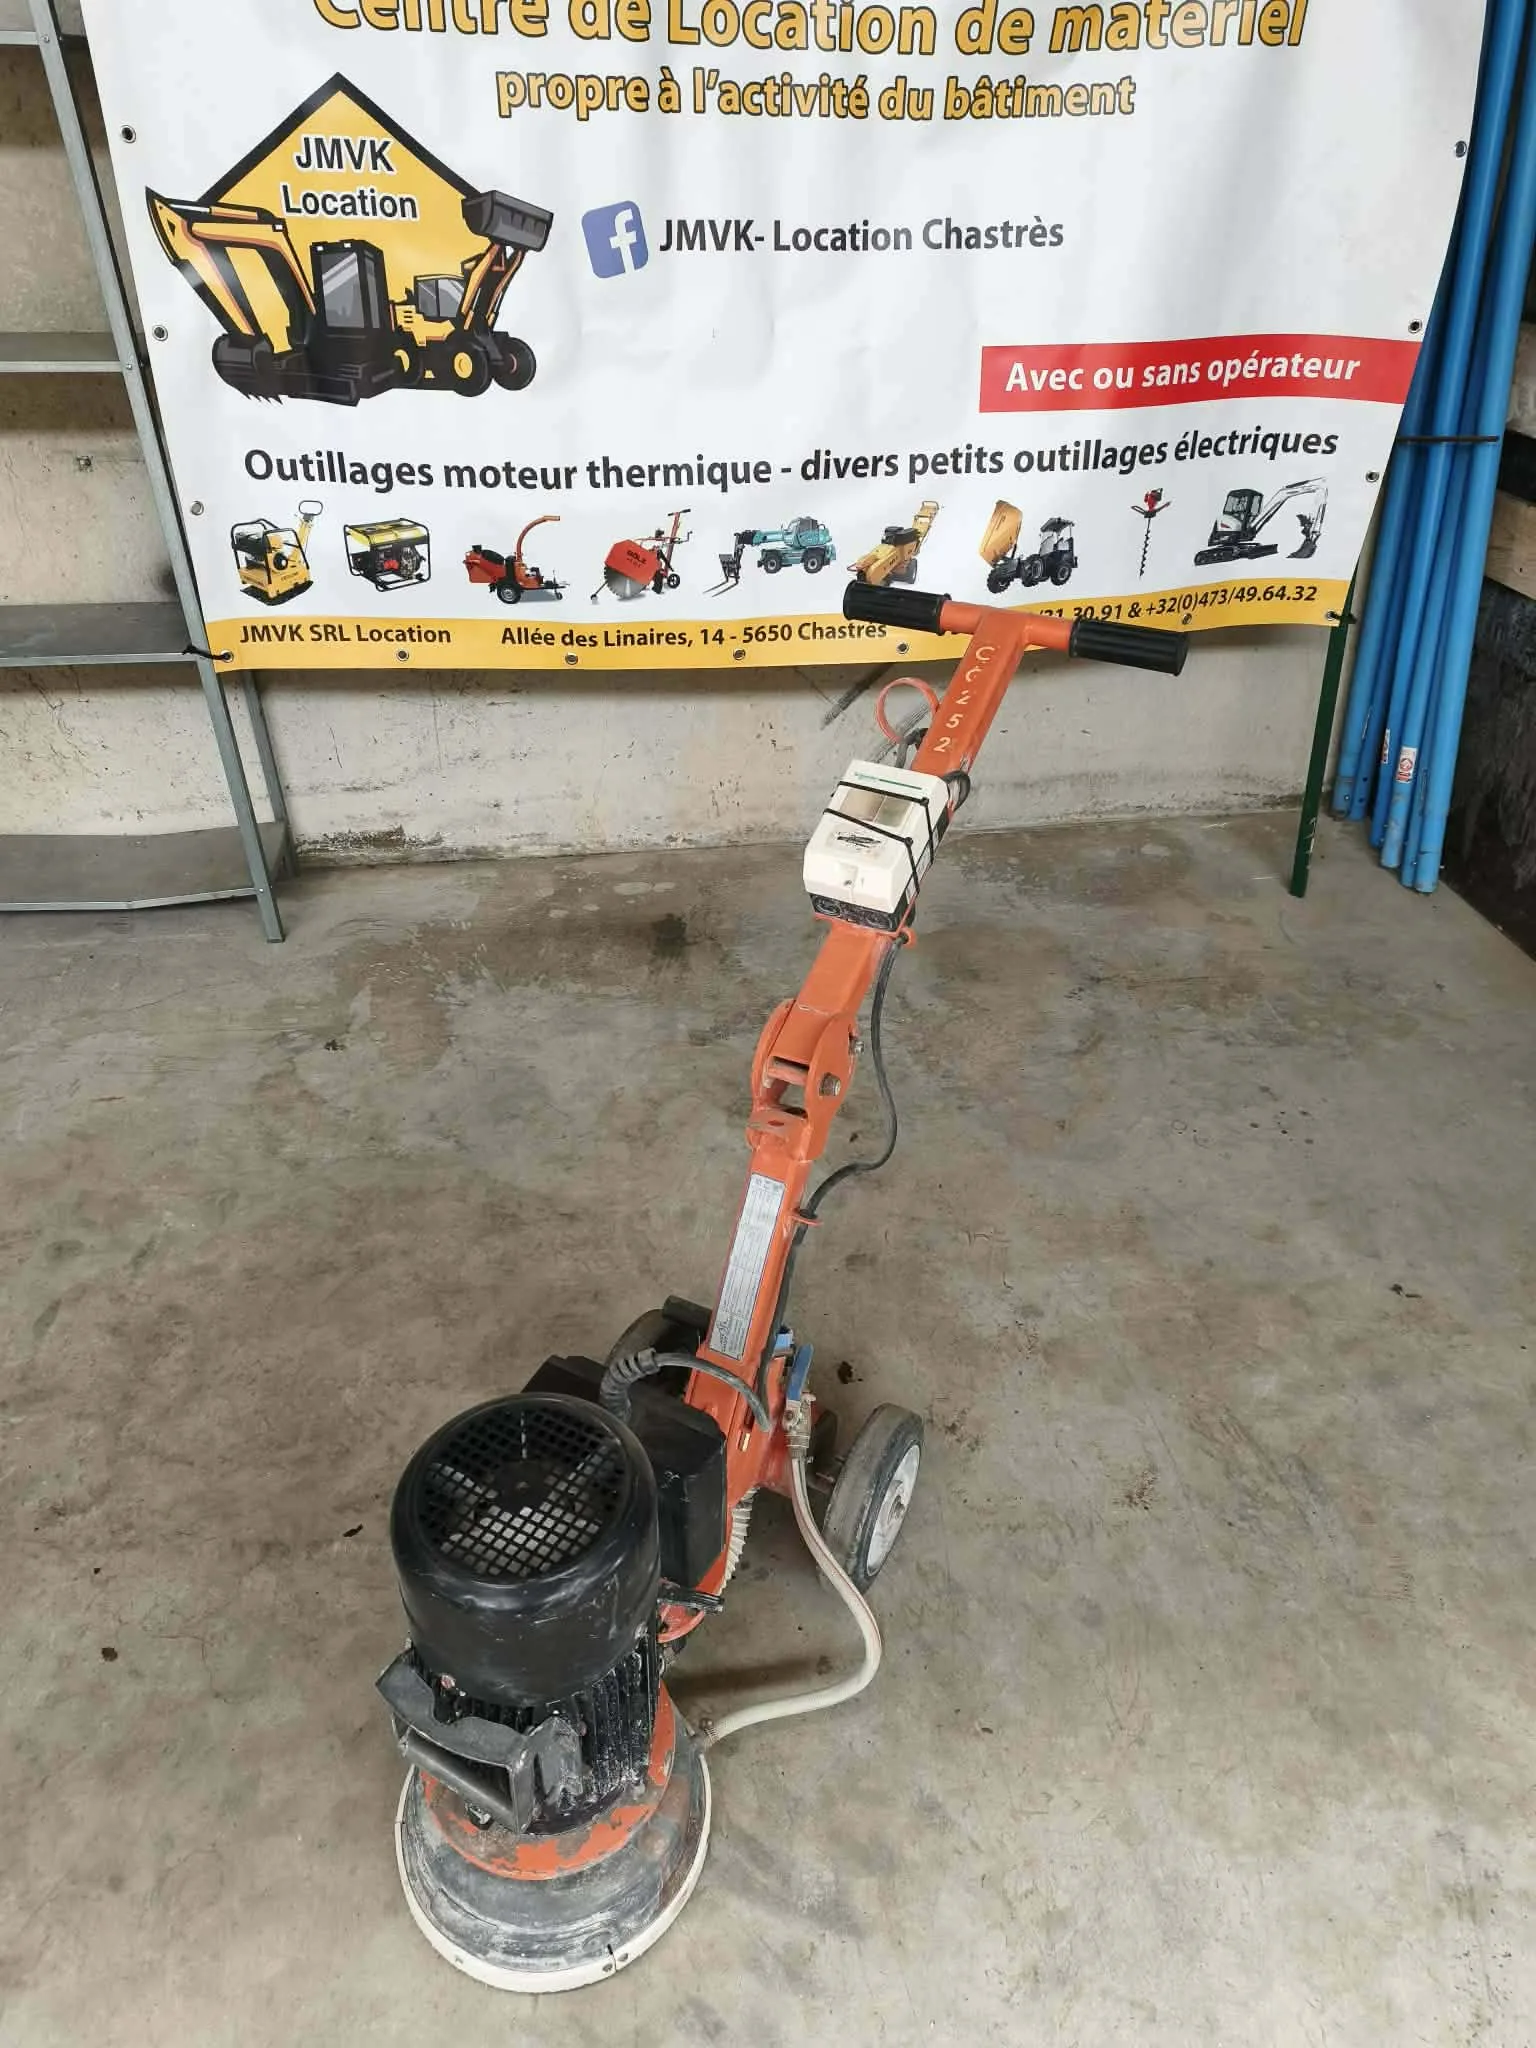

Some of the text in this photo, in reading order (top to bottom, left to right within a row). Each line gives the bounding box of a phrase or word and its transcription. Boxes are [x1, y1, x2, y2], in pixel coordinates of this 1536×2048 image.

[567, 0, 653, 41] de
[667, 0, 937, 55] Location
[954, 0, 1035, 55] de
[496, 69, 650, 121] propre
[658, 67, 681, 113] à
[879, 76, 935, 120] du
[943, 75, 1137, 120] bâtiment
[295, 136, 394, 173] JMVK
[281, 185, 419, 220] Location
[659, 215, 1065, 252] JMVK- Location Chastrès
[1004, 349, 1361, 393] Avec ou sans opérateur
[244, 449, 435, 494] Outillages
[443, 461, 579, 490] moteur
[586, 454, 772, 493] thermique
[800, 448, 900, 481] divers
[908, 442, 1002, 484] petits
[1013, 438, 1168, 476] outillages
[1174, 424, 1339, 463] électriques
[240, 624, 305, 644] JMVK
[309, 624, 351, 643] SRL
[356, 624, 452, 644] Location
[501, 627, 556, 646] Allée
[560, 629, 599, 647] des
[604, 629, 694, 648] Linaires,
[699, 628, 725, 646] 14
[742, 623, 793, 644] 5650
[1127, 602, 1142, 619] &
[1145, 585, 1318, 615] +32(0)473/49.64.32
